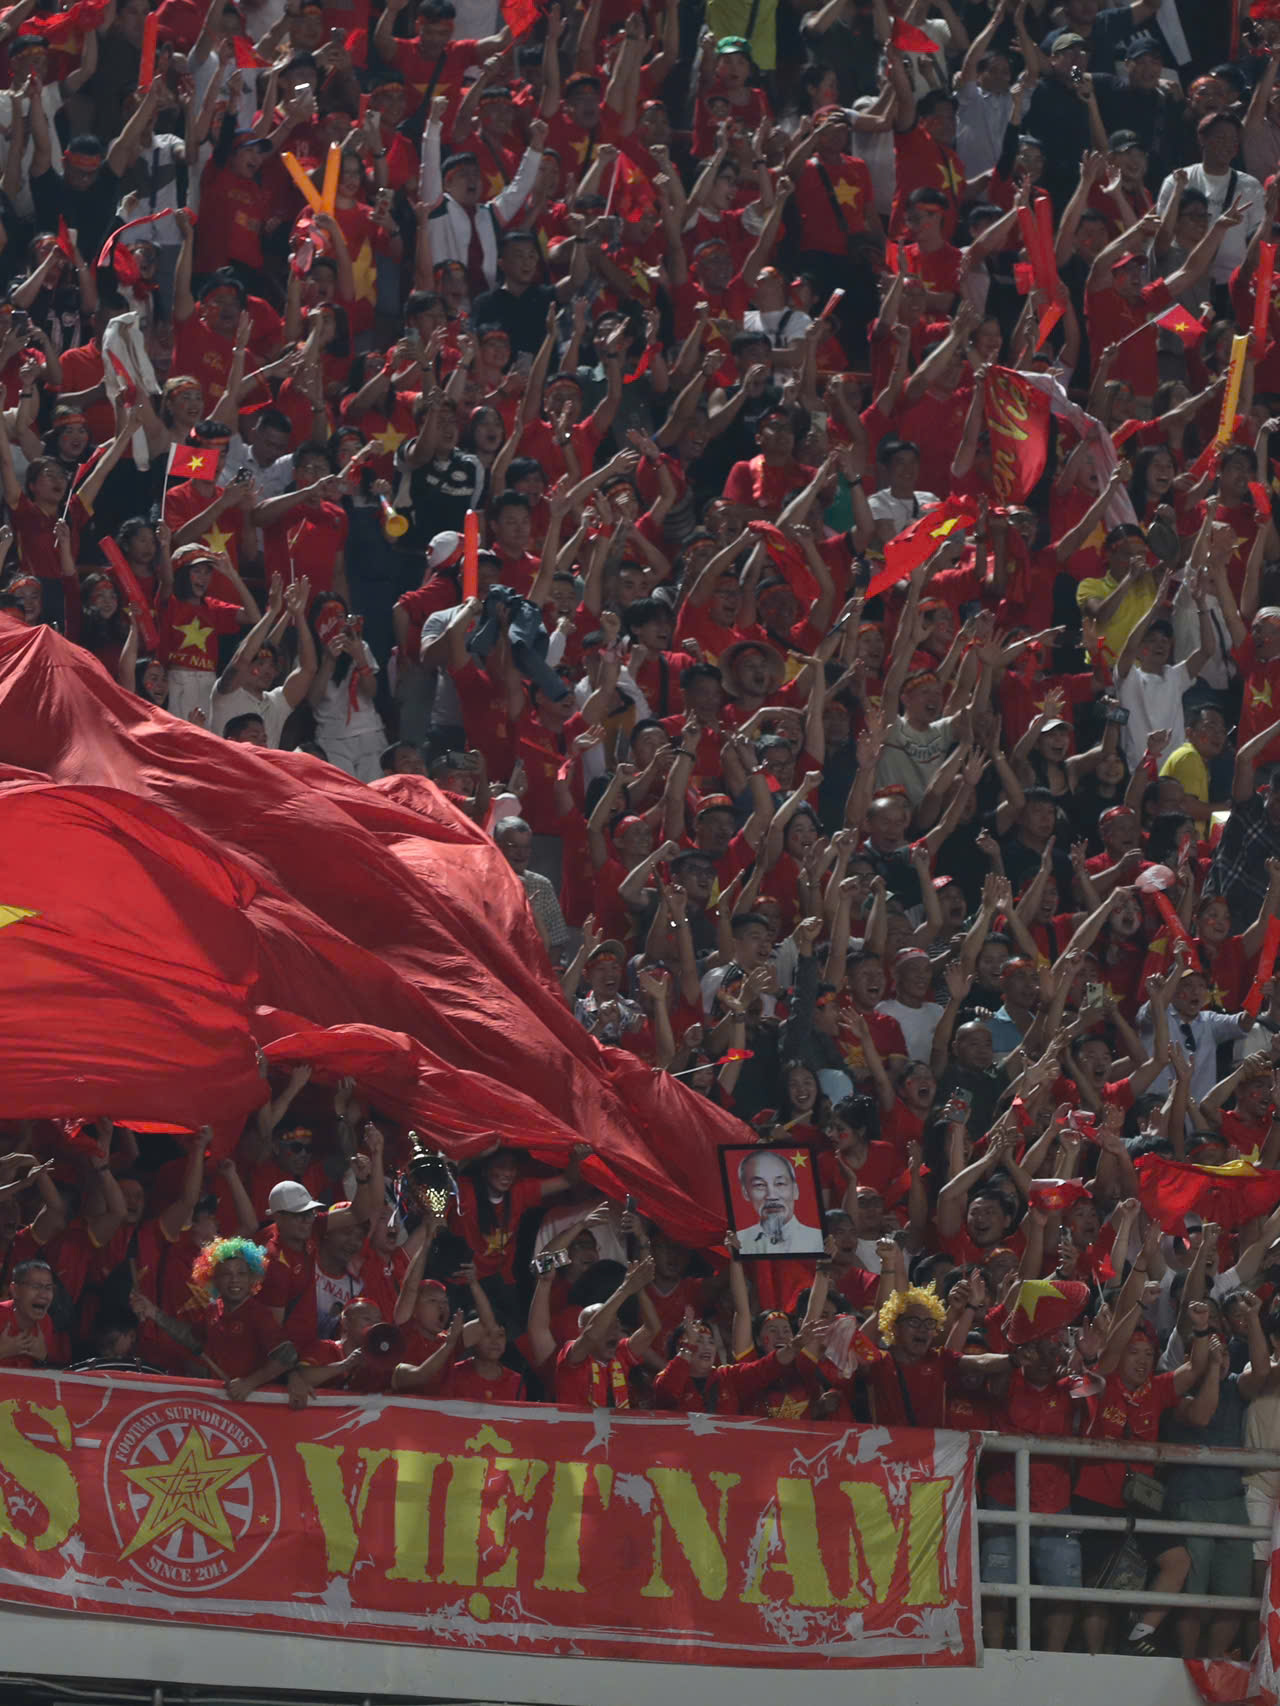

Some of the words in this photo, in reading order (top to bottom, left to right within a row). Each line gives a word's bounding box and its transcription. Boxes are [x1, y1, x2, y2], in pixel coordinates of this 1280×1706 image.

[114, 1412, 164, 1463] FOOTBALL
[164, 1406, 253, 1449] SUPPORTERS
[296, 1424, 613, 1621] VIỆT
[640, 1467, 956, 1608] NAM
[146, 1556, 192, 1583] SINCE
[195, 1559, 230, 1582] 2014
